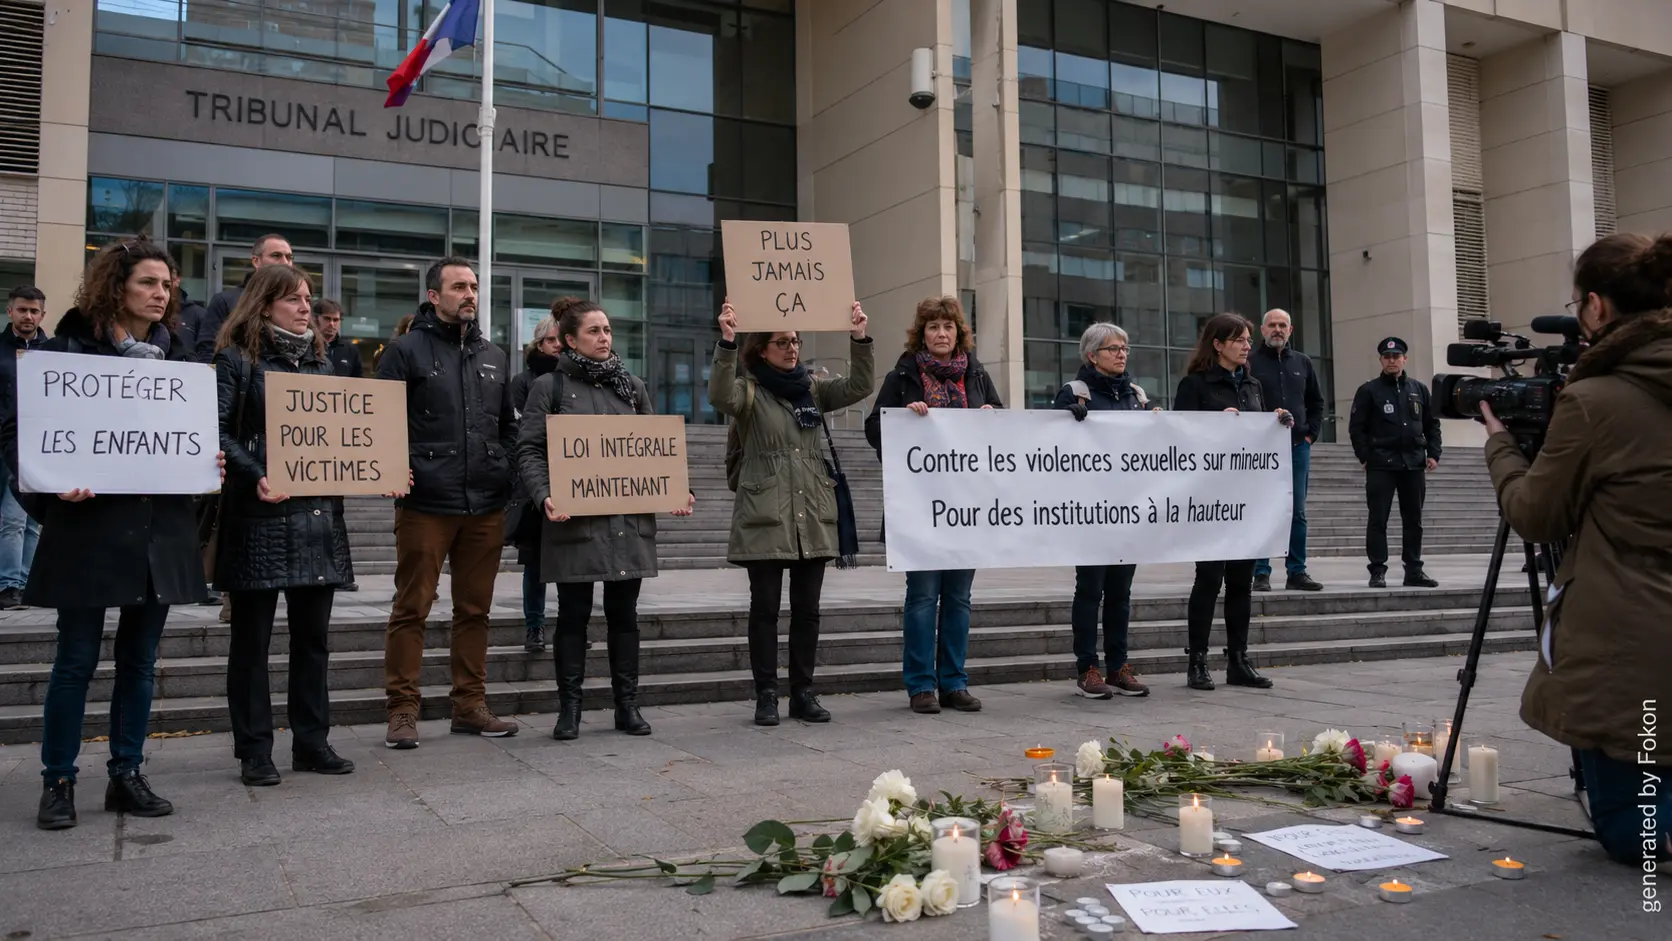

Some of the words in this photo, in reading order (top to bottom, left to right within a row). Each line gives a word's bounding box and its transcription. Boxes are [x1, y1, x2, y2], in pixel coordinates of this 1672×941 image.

[186, 89, 367, 137] TRIBUNAL
[386, 114, 570, 159] JUDICAIRE
[760, 230, 813, 251] PLUS
[775, 292, 807, 318] ÇA
[43, 370, 187, 403] PROTÉGER
[42, 430, 77, 454] LES
[93, 429, 201, 456] ENFANTS
[280, 424, 329, 447] POUR
[341, 427, 373, 448] LES
[563, 437, 590, 459] LOI
[906, 446, 979, 474] Contre
[987, 445, 1017, 473] les
[1025, 445, 1113, 473] violences
[1120, 446, 1197, 473] sexuelles
[1202, 453, 1227, 472] sur
[1229, 447, 1280, 471] mineurs
[931, 500, 982, 528] Pour
[987, 498, 1024, 527] des
[1033, 499, 1141, 526] institutions
[1147, 497, 1158, 524] à
[1165, 497, 1180, 524] la
[1187, 497, 1247, 523] hauteur
[1128, 888, 1186, 900] POUR
